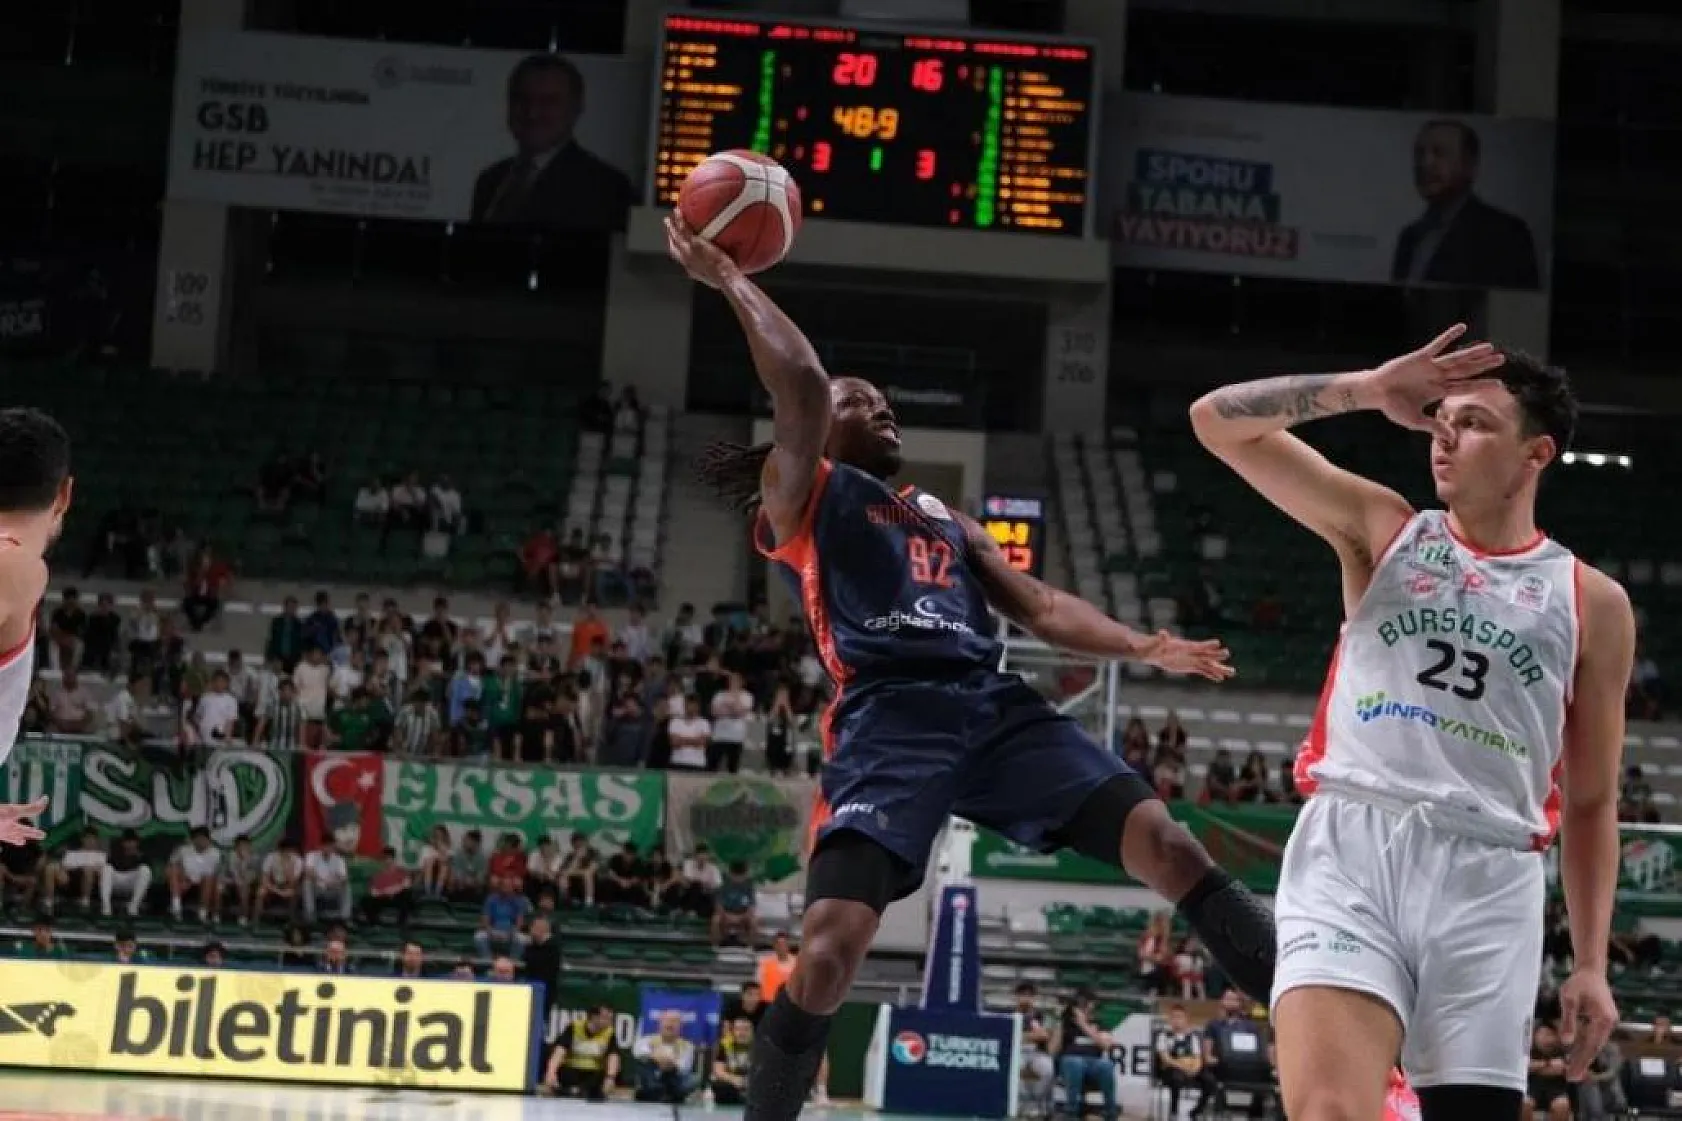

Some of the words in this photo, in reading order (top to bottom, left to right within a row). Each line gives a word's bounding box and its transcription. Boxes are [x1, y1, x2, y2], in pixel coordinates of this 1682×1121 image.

[833, 53, 878, 86] 20
[911, 58, 944, 91] 16
[196, 101, 269, 132] GSB
[192, 138, 257, 171] HEP
[271, 144, 431, 184] YANINDA!
[812, 142, 832, 172] 3
[914, 149, 936, 179] 3
[1147, 156, 1256, 191] SPORU
[1139, 186, 1266, 221] TABANA
[1118, 212, 1295, 256] YAYIYORUZ
[908, 535, 954, 589] 92
[1377, 606, 1544, 688] BURSASPOR
[1416, 638, 1490, 701] 23
[109, 971, 494, 1074] biletinial
